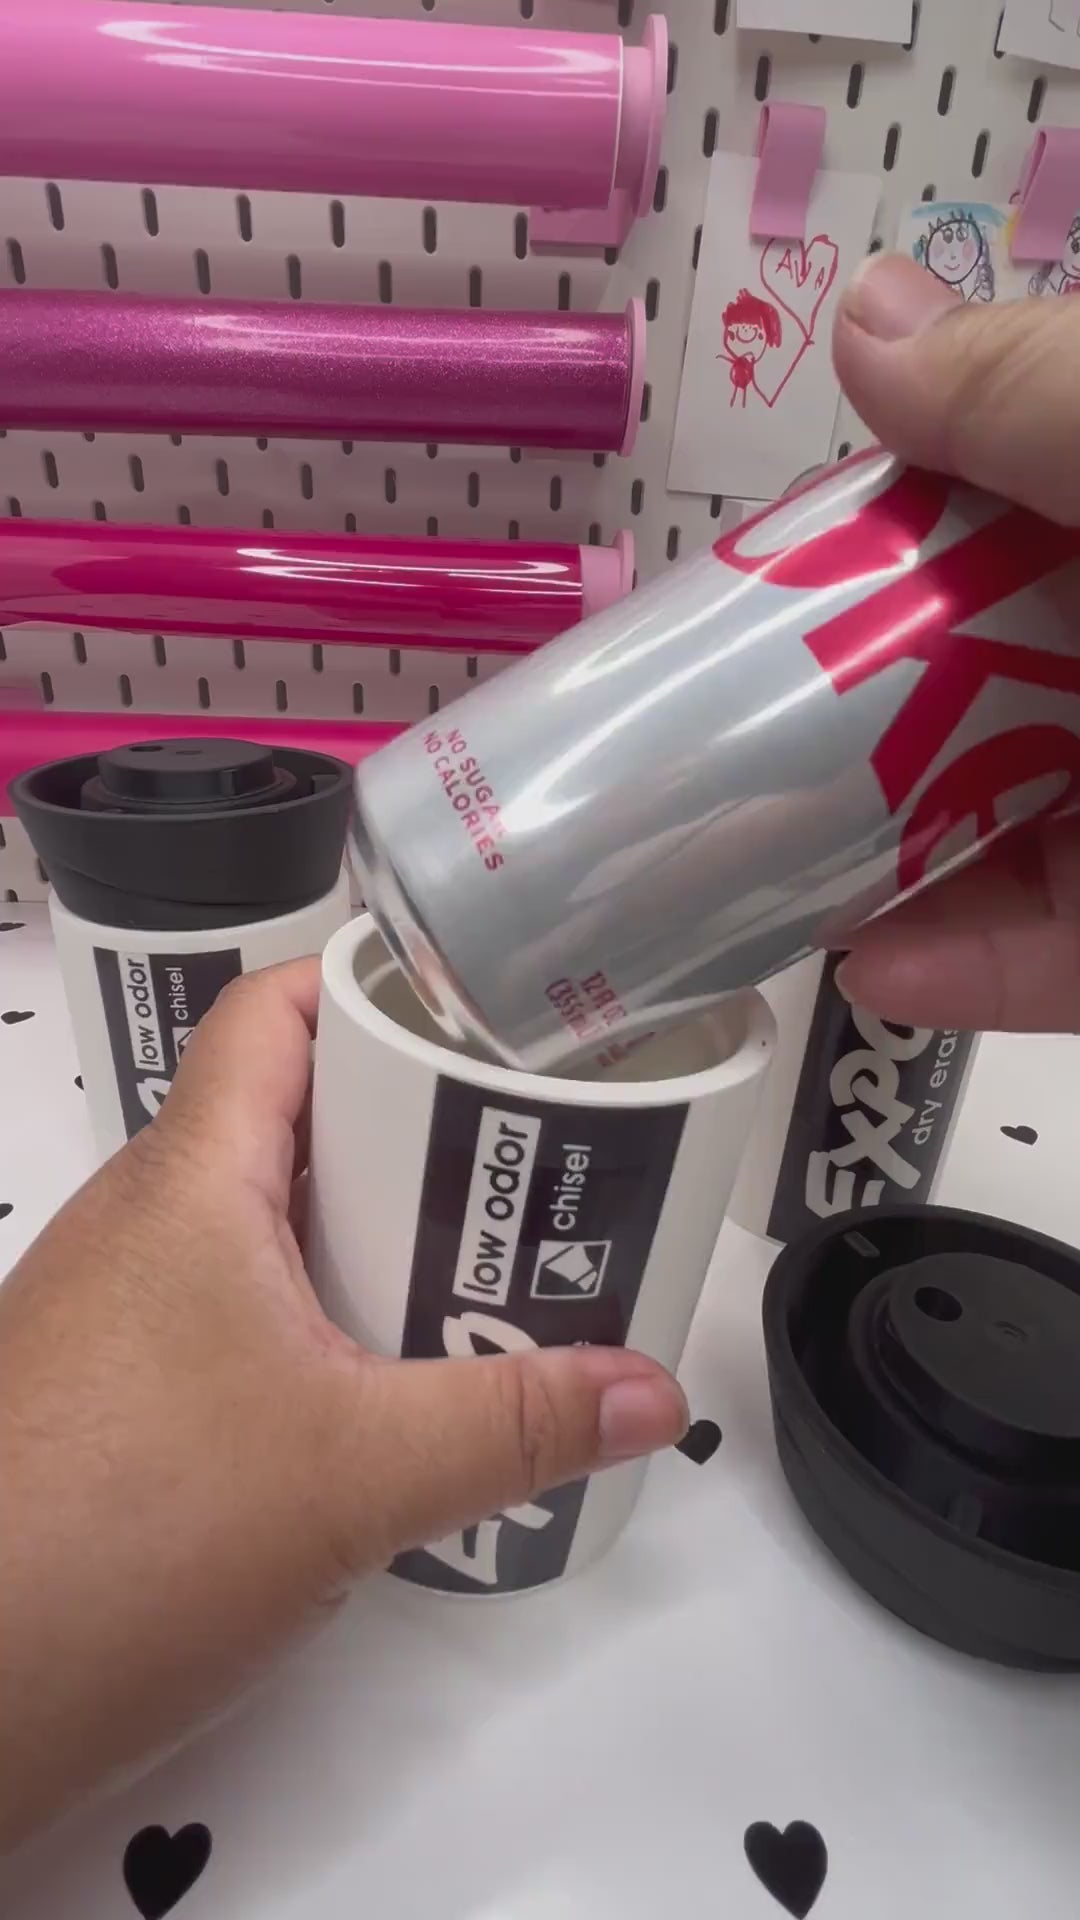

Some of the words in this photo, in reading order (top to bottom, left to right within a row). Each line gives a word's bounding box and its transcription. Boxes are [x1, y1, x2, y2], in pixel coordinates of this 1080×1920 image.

[424, 730, 442, 754] NO
[434, 756, 504, 871] CALORIES
[448, 729, 467, 754] NO
[459, 757, 507, 838] SUGA
[127, 958, 152, 1019] odor
[165, 967, 189, 1021] chisel
[139, 1025, 159, 1066] low
[912, 1098, 943, 1145] dry
[483, 1121, 529, 1221] odor
[550, 1144, 592, 1231] chisel
[464, 1230, 507, 1296] low
